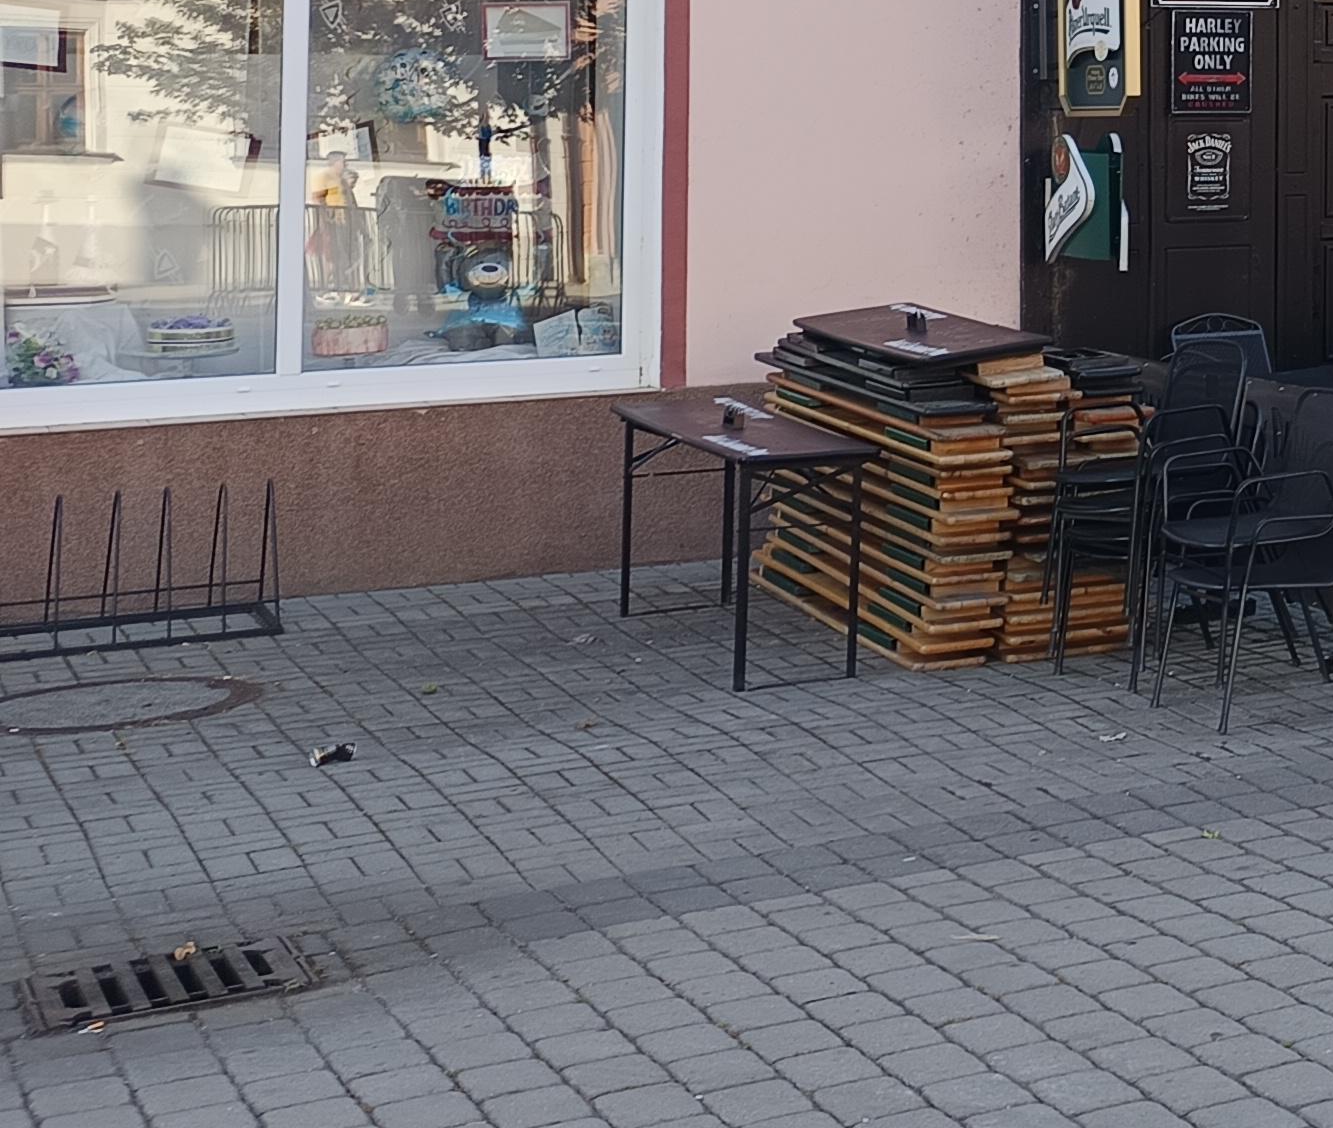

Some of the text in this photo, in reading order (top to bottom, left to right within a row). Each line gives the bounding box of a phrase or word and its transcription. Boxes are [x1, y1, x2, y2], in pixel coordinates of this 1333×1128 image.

[1185, 17, 1242, 34] HARLEY
[1180, 36, 1245, 53] PARKING
[1193, 54, 1233, 70] ONLY
[445, 197, 519, 217] BIRTHDA
